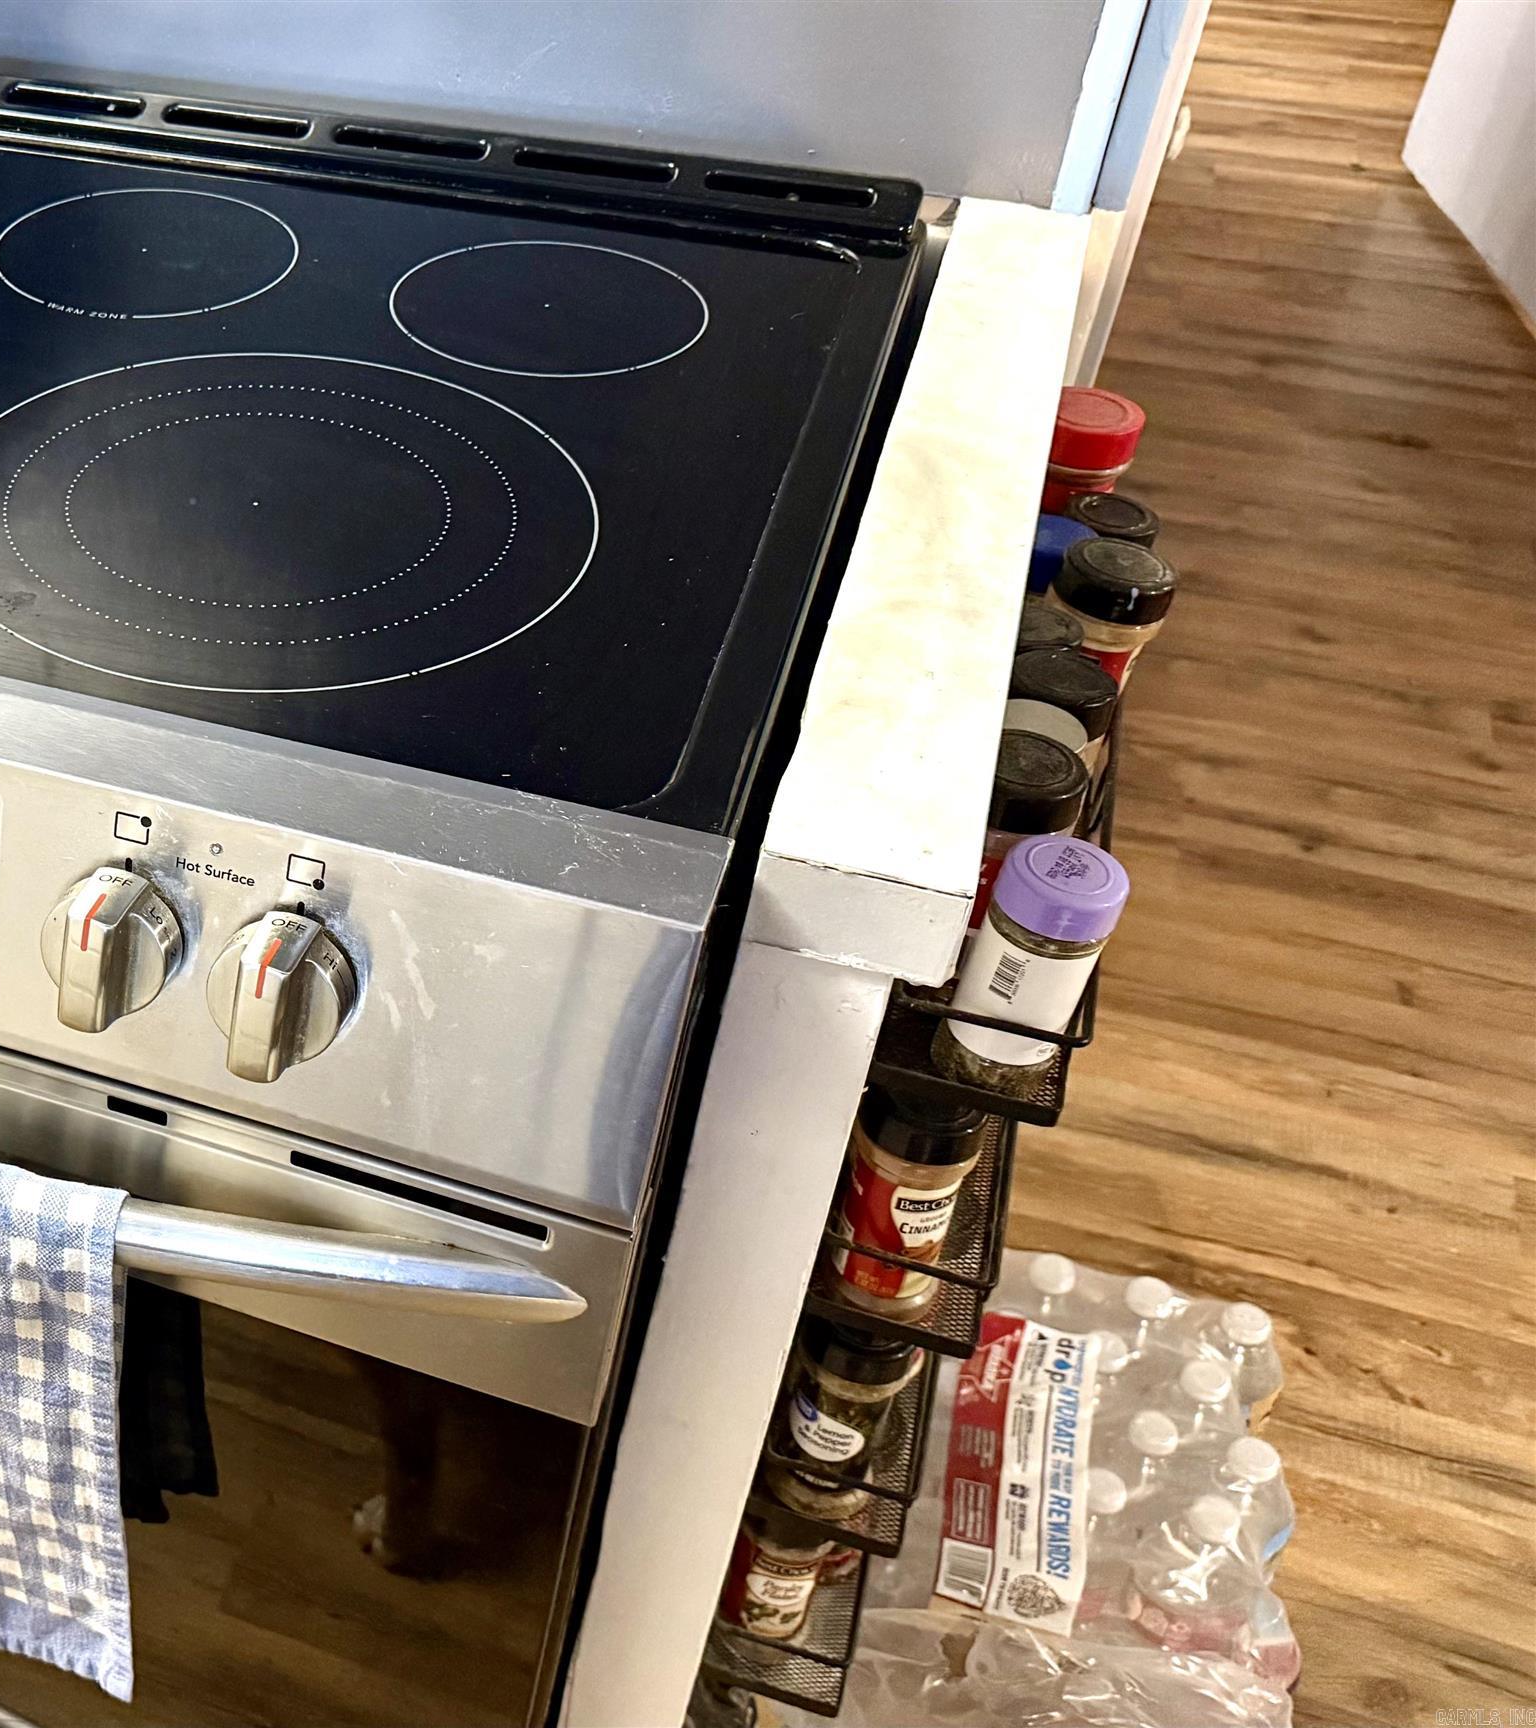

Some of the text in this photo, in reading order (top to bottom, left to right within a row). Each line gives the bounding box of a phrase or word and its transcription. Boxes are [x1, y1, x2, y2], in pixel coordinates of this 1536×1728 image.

[47, 302, 128, 320] WARM ZONE
[175, 856, 256, 887] Hot Surface
[99, 875, 133, 887] OFF
[149, 907, 163, 925] Lo
[271, 919, 308, 932] OFF
[323, 952, 338, 970] Hi
[899, 1199, 930, 1212] Best
[1052, 1385, 1079, 1459] HYDRATE
[1046, 1493, 1072, 1580] REWARDS!
